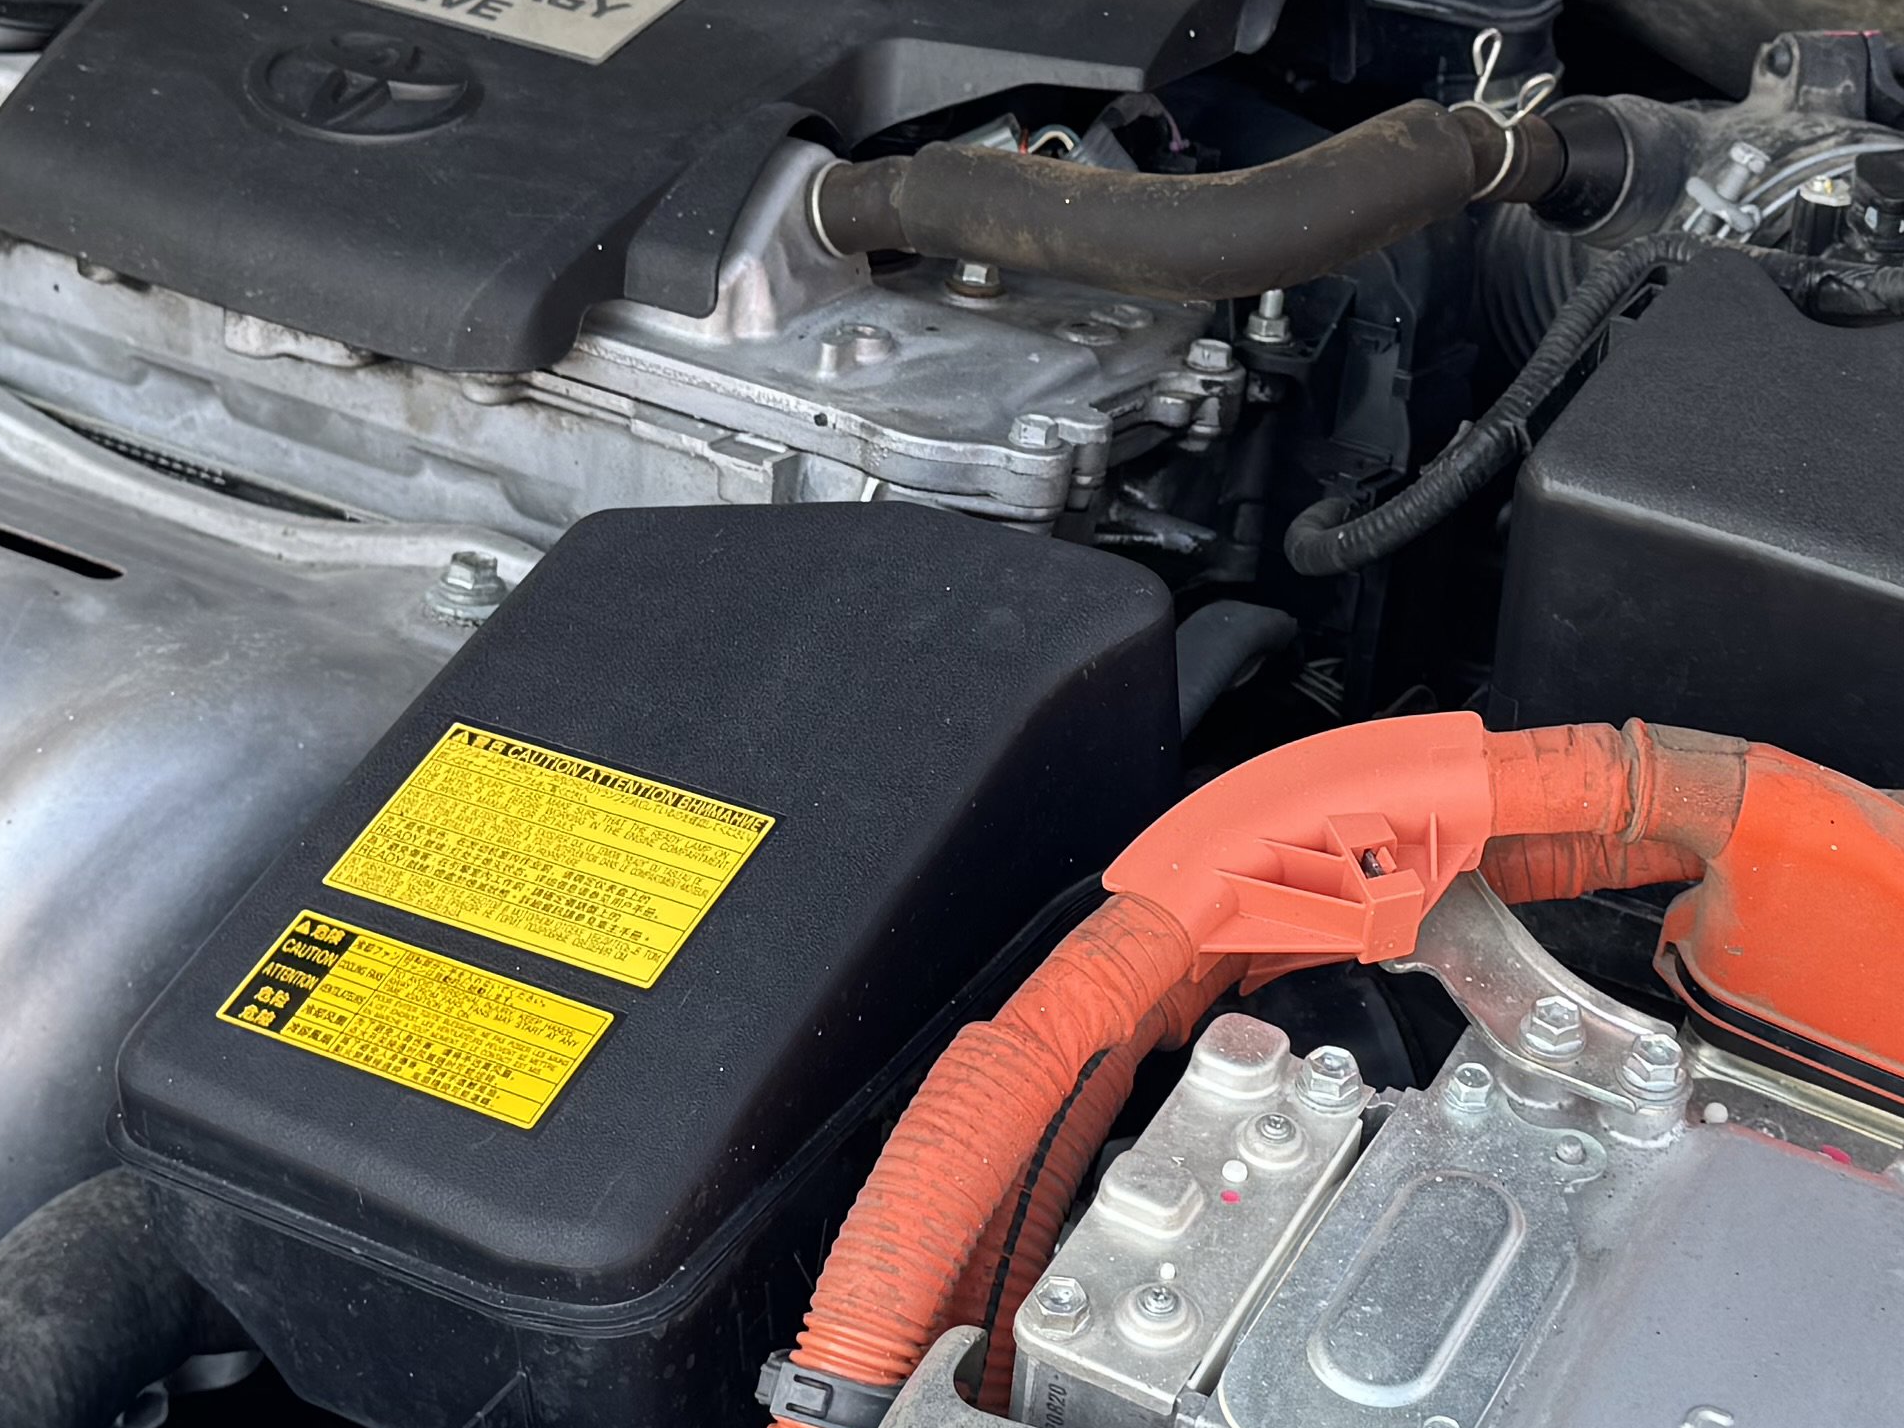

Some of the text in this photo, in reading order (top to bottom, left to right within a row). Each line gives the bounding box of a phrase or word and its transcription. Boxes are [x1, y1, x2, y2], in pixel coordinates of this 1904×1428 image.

[503, 744, 585, 778] CAUTION
[578, 766, 681, 807] ATTENTION
[278, 936, 340, 968] CAUTION
[258, 959, 321, 992] ATTENTION
